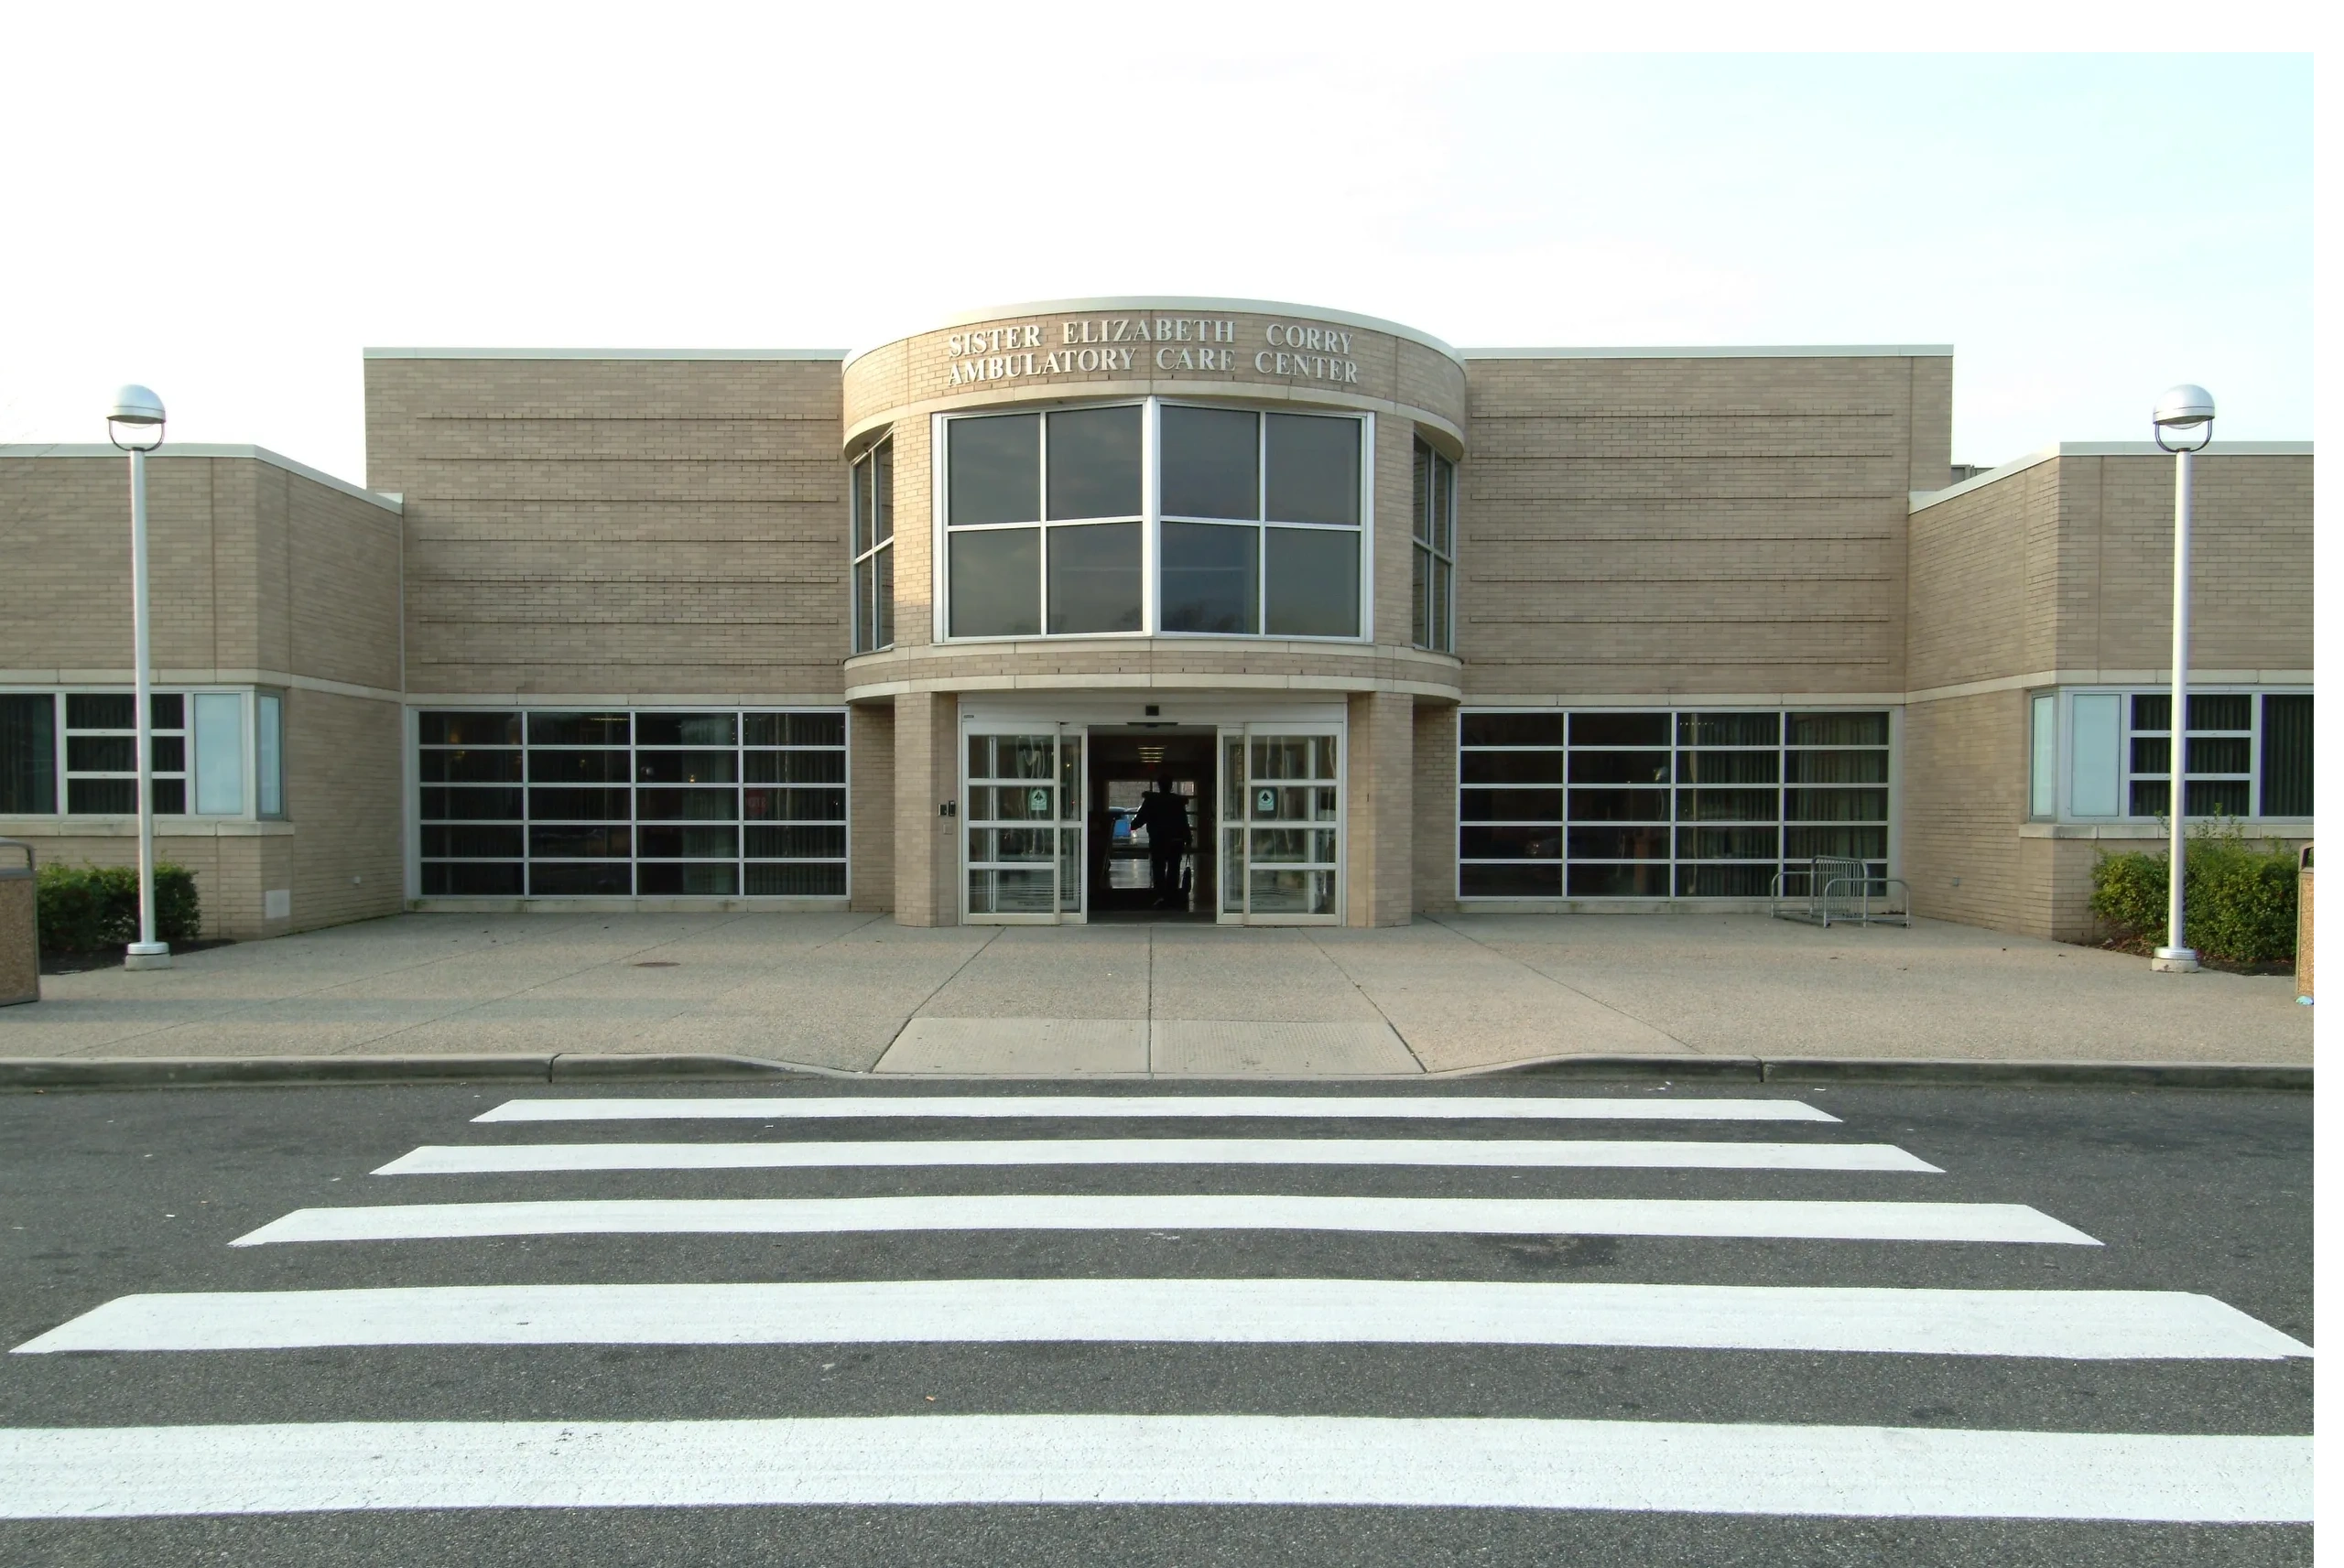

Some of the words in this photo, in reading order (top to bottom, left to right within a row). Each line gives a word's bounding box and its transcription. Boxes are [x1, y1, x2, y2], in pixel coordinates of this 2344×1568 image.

[949, 325, 1041, 358] SISTER
[1062, 319, 1235, 344] ELIZABETH
[1266, 323, 1354, 355] CORRY
[948, 348, 1136, 387] AMBULATORY
[1156, 347, 1236, 372] CARE
[1254, 351, 1358, 384] CENTER
